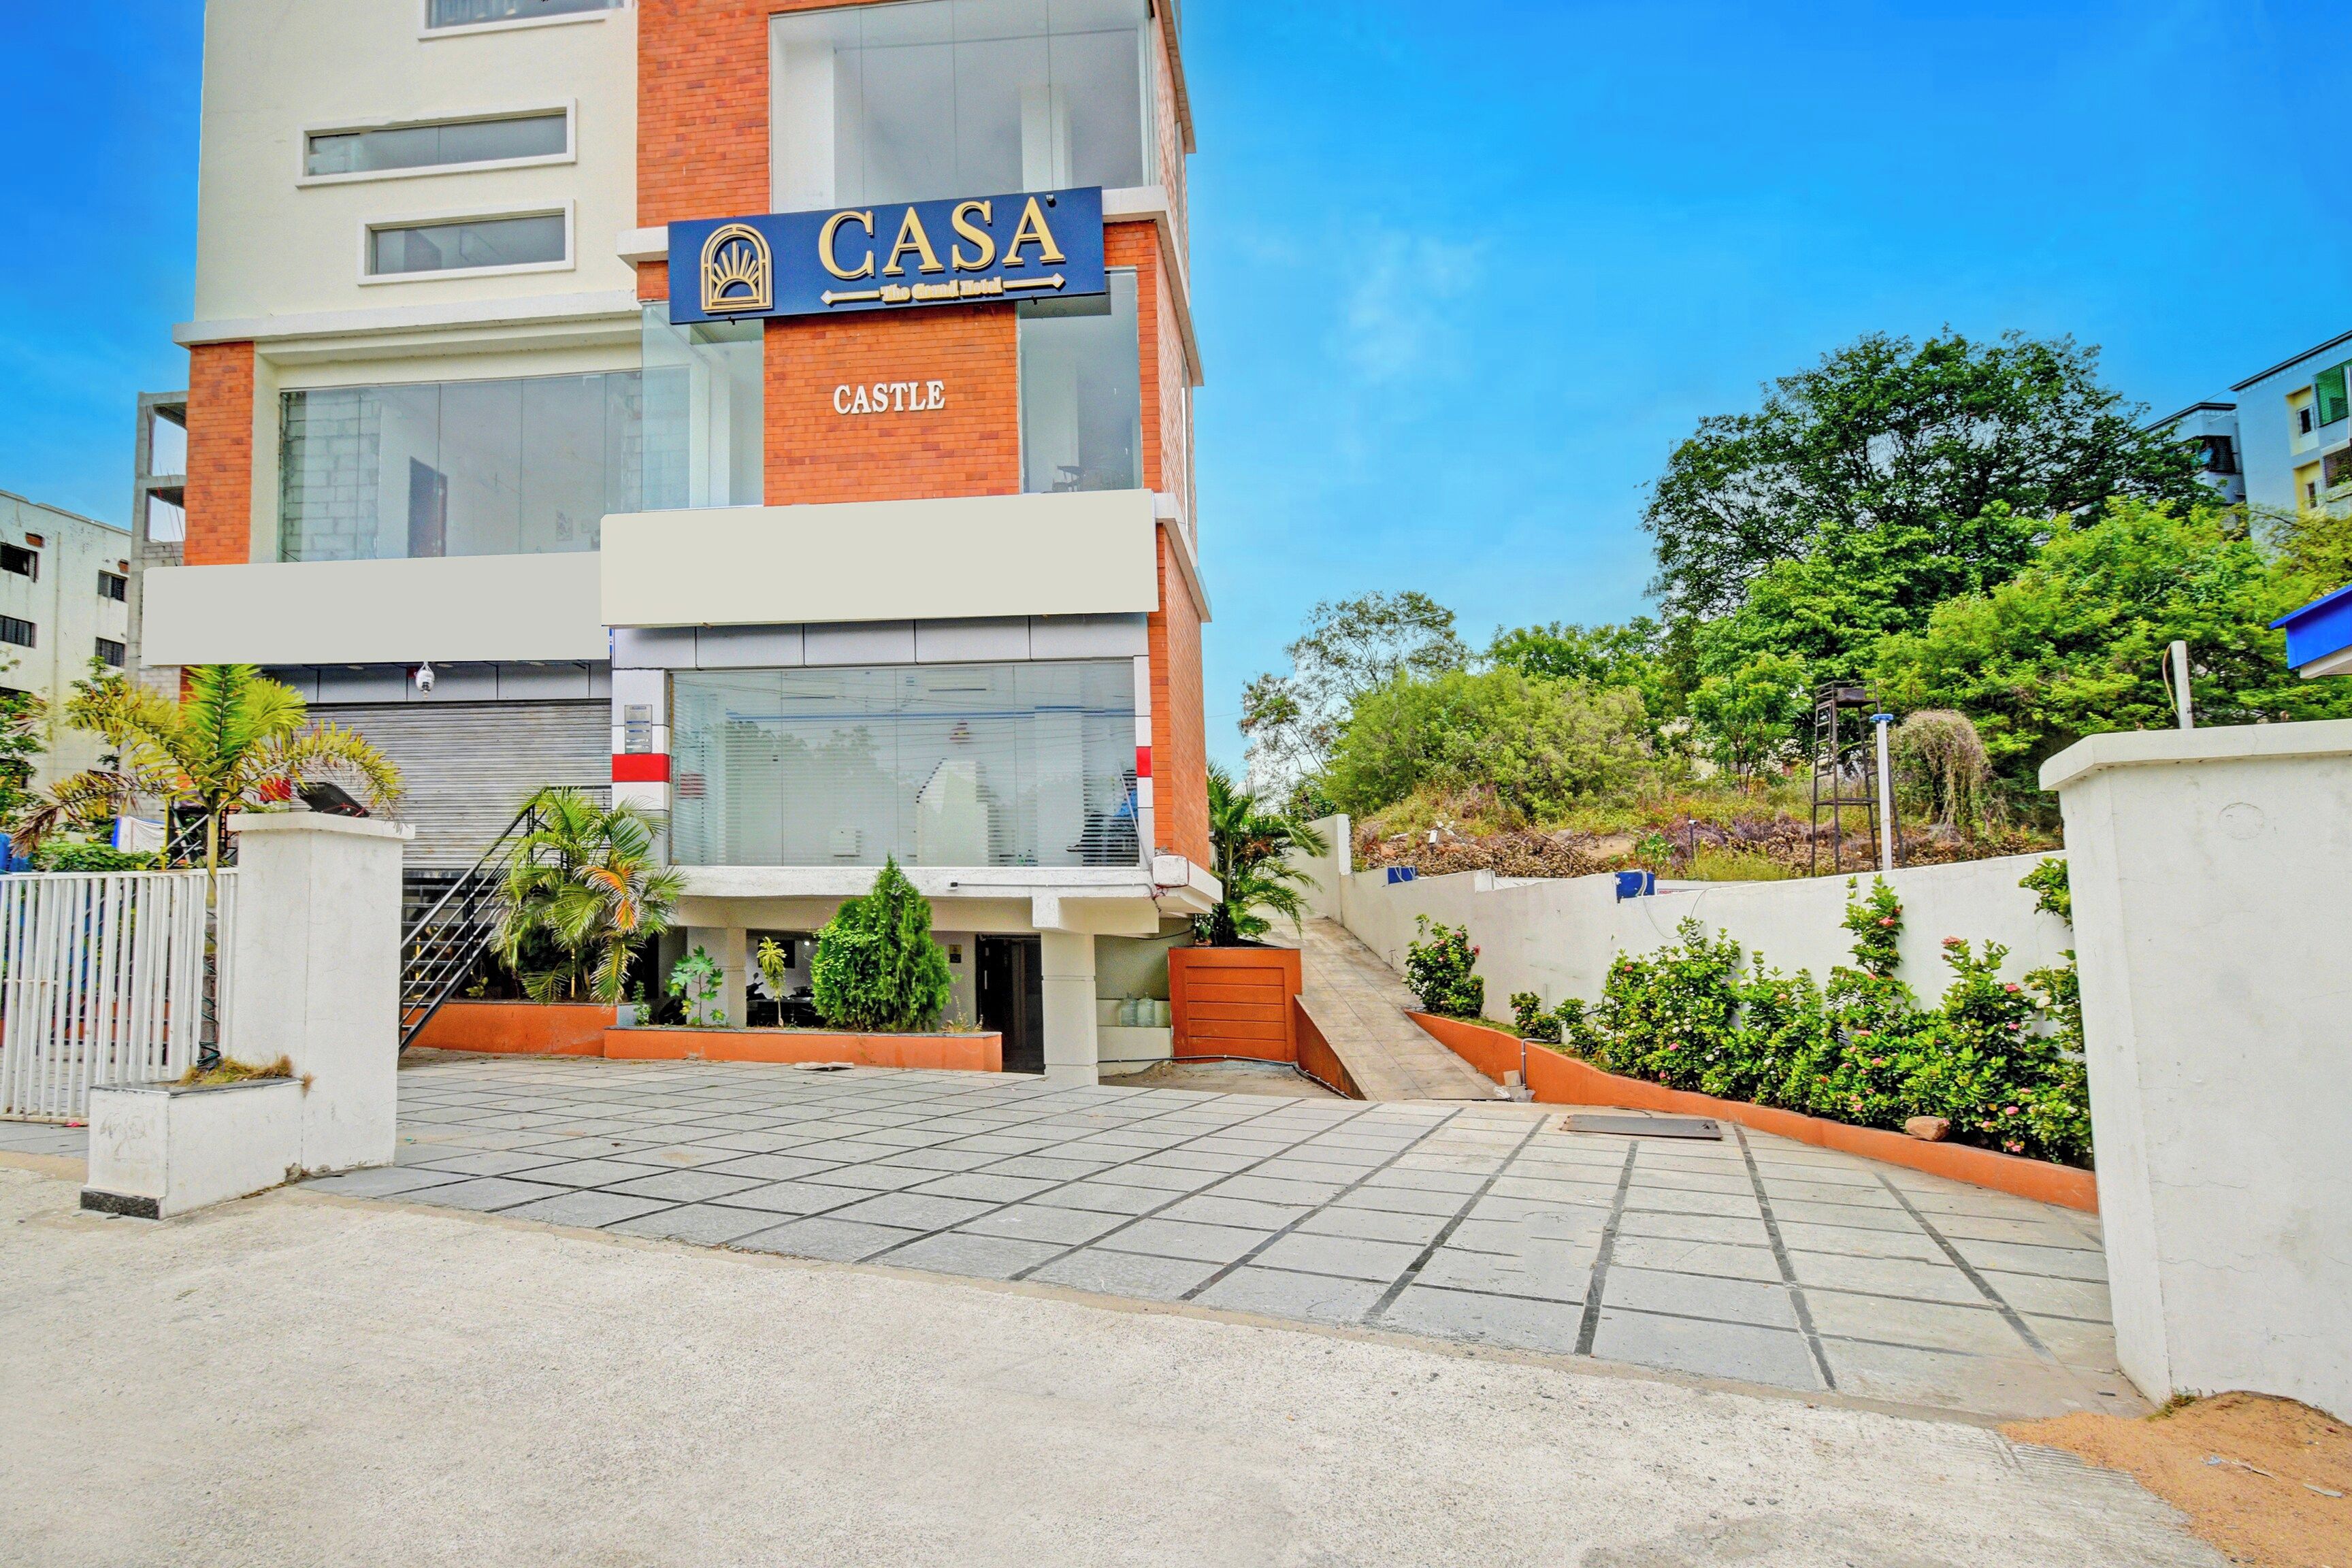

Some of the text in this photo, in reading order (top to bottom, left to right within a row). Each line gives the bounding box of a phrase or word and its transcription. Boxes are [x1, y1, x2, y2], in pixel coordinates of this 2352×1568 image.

[818, 196, 1066, 280] CASA
[881, 276, 1003, 301] The Grand Hotel
[833, 380, 946, 414] CASTLE
